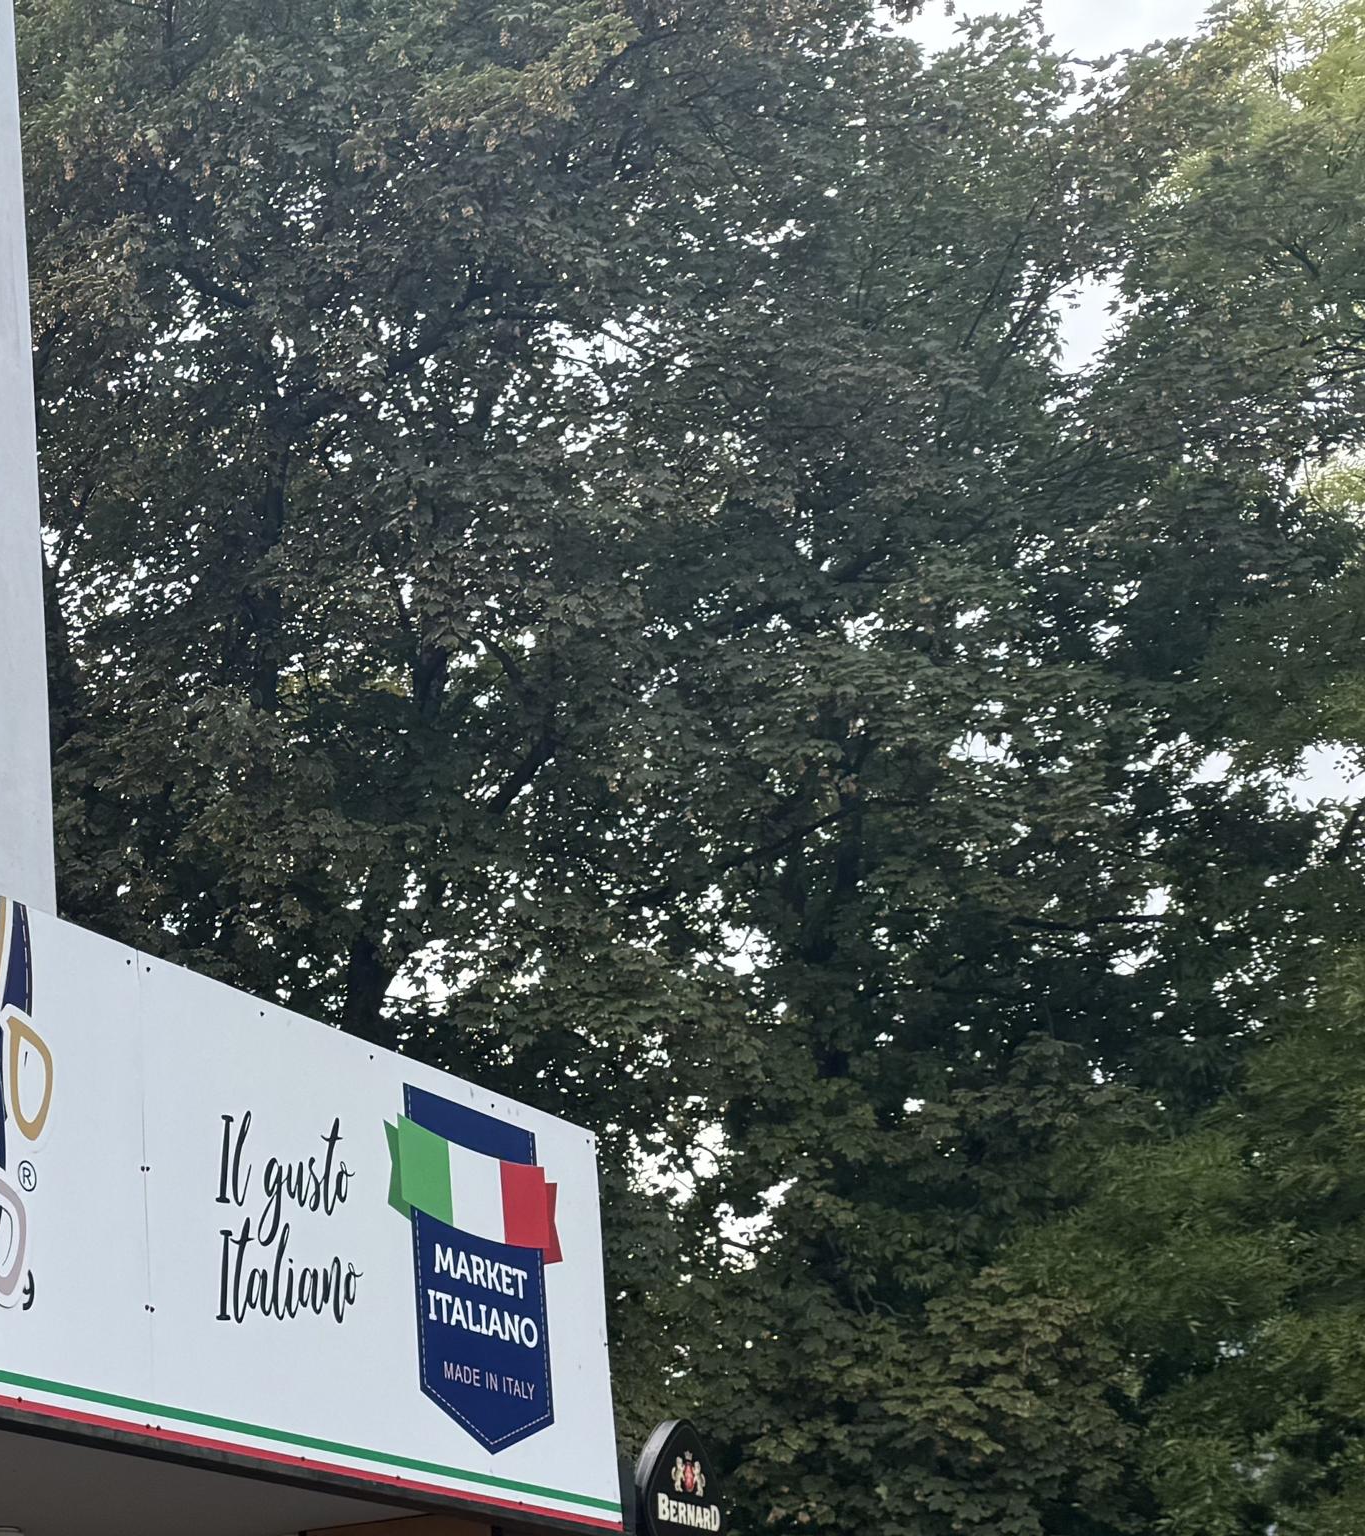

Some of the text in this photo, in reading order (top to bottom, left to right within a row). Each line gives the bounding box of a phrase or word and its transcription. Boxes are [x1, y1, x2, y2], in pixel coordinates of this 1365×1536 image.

[215, 1111, 355, 1246] Il gusto
[215, 1216, 363, 1324] Italiano
[434, 1243, 527, 1299] MARKET
[427, 1288, 538, 1348] ITALIANO
[443, 1360, 535, 1400] MADE IN ITALY
[657, 1492, 720, 1532] BERNARD
